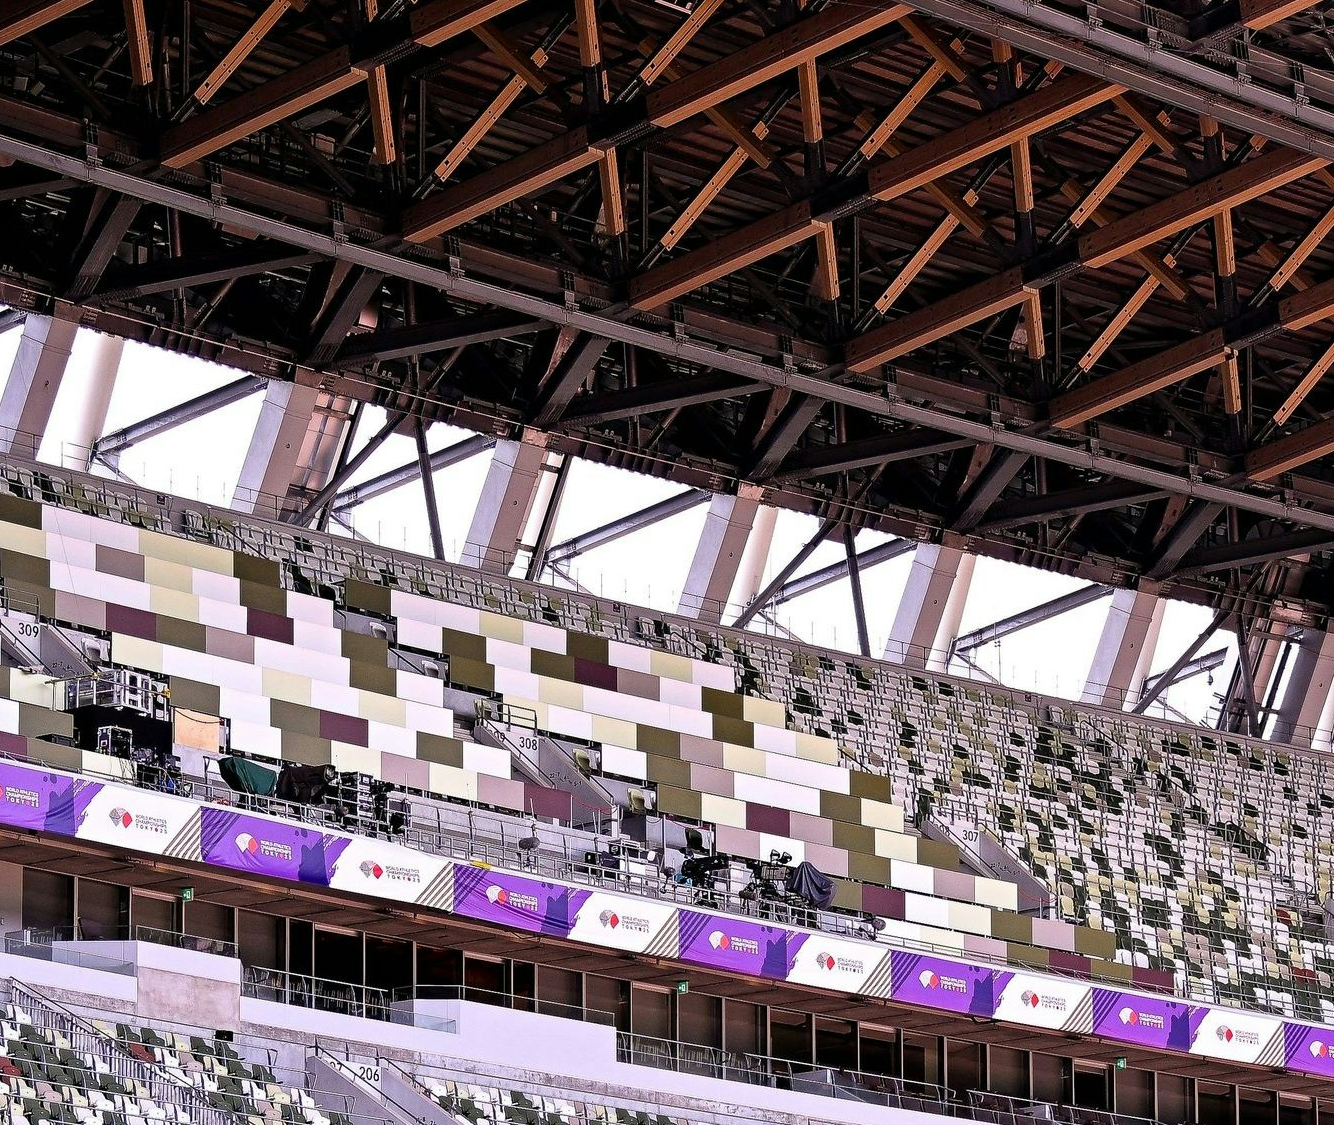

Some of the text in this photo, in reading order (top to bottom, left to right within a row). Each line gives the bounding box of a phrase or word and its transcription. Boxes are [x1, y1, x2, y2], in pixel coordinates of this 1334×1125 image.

[18, 622, 39, 638] 309
[519, 736, 538, 751] 308
[962, 829, 979, 842] 307
[359, 1066, 379, 1081] 206
